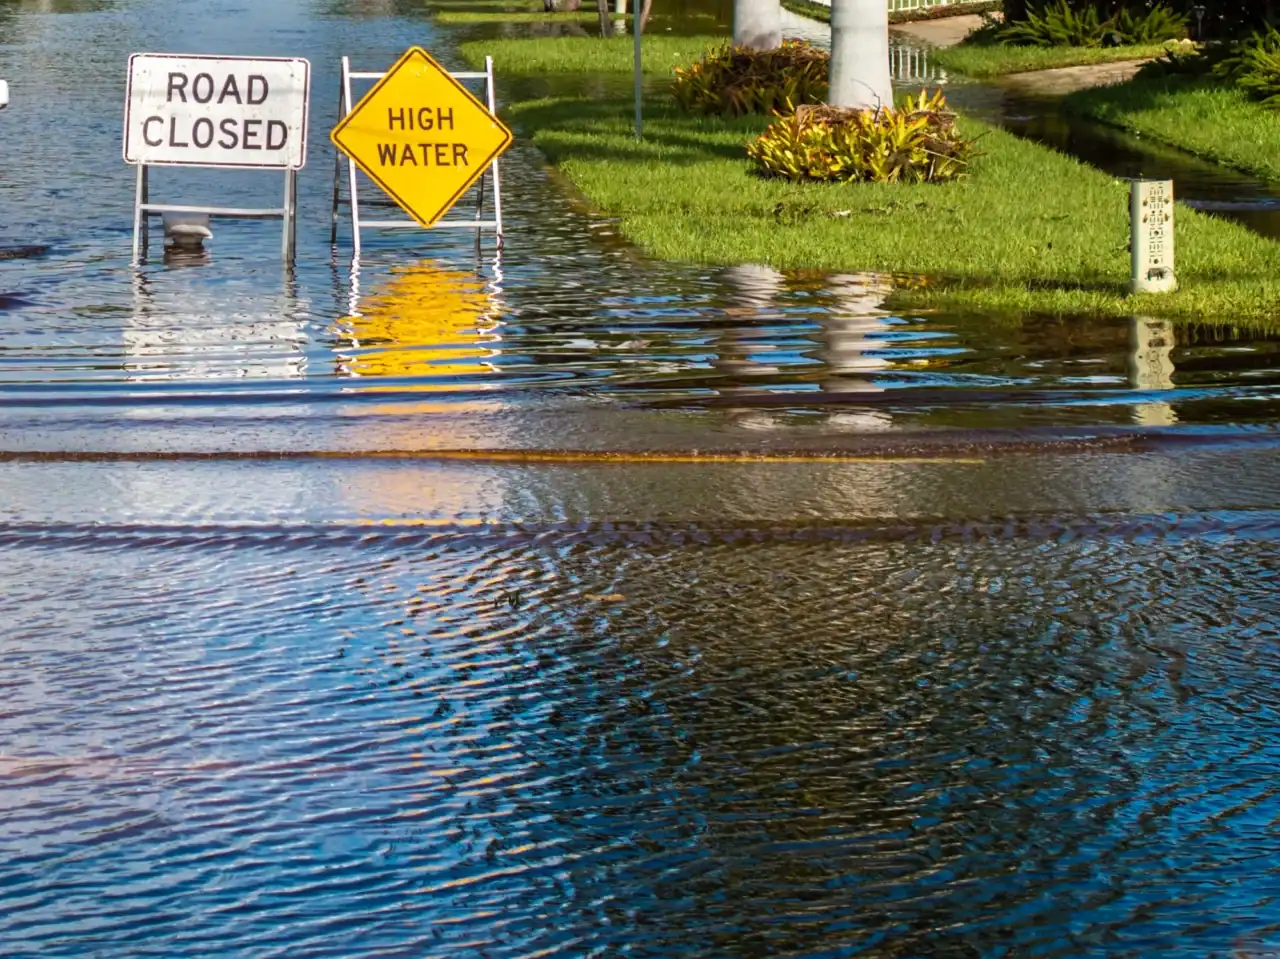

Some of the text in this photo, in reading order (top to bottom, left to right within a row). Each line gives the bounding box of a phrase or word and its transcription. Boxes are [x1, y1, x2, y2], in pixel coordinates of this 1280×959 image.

[167, 71, 269, 105] ROAD
[142, 116, 288, 151] CLOSED
[387, 107, 454, 132] HIGH
[377, 143, 469, 167] WATER
